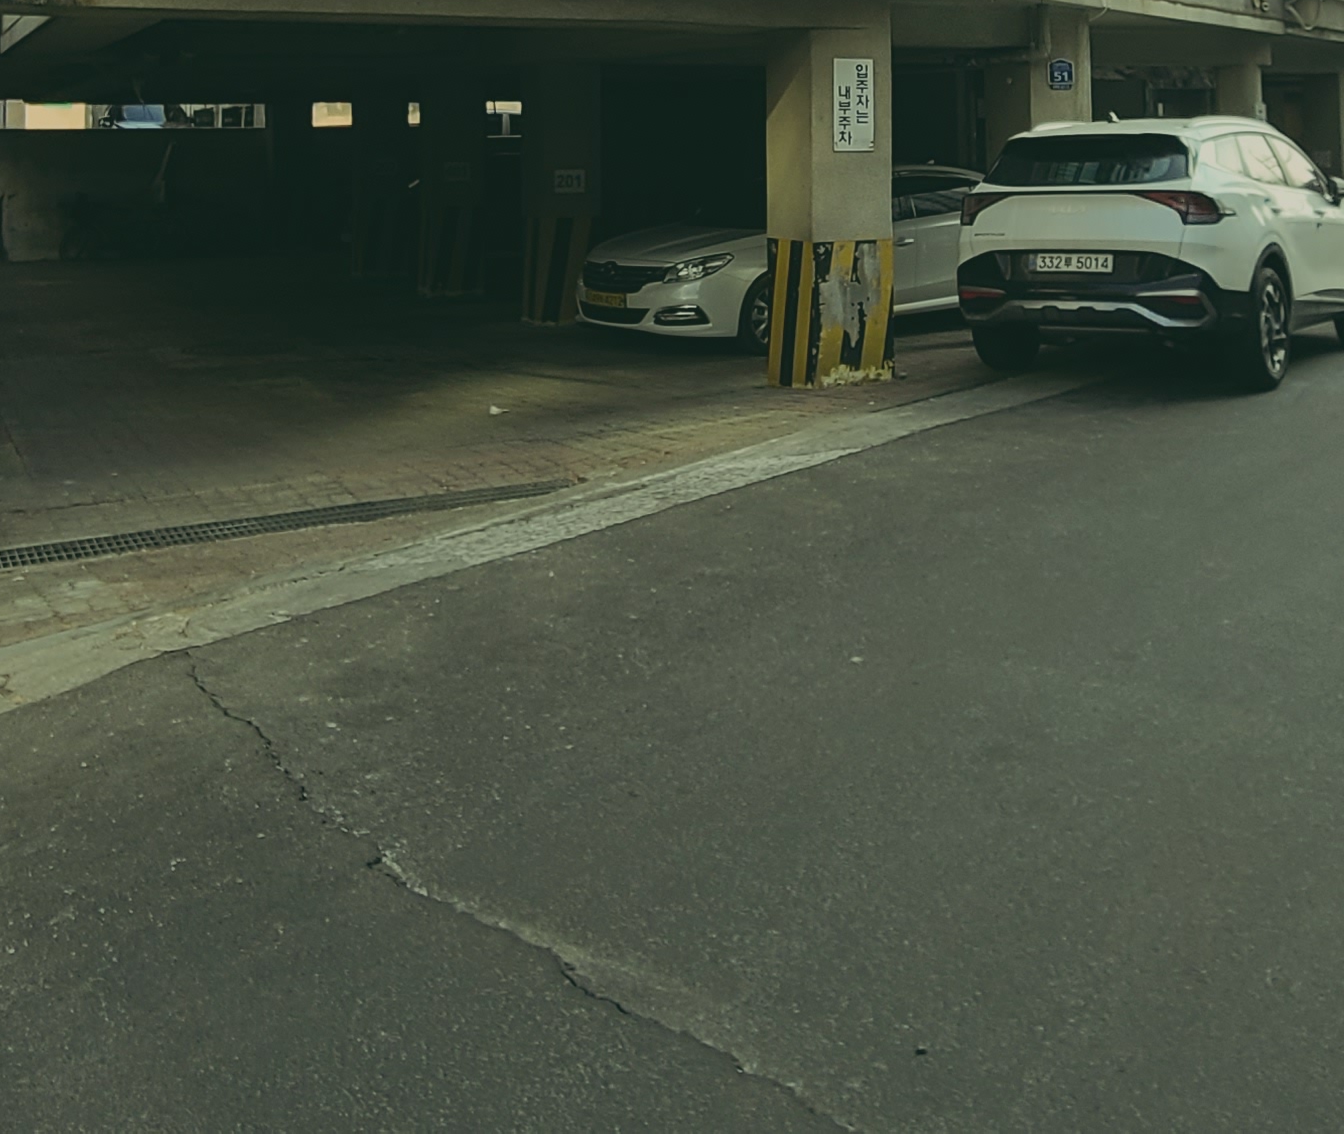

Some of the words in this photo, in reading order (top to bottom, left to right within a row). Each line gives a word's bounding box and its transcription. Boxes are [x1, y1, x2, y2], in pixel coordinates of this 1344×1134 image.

[1053, 71, 1069, 82] 51
[855, 64, 869, 124] 입주자는
[838, 85, 852, 146] 내부주차
[556, 174, 581, 188] 201
[1076, 256, 1109, 270] 5014
